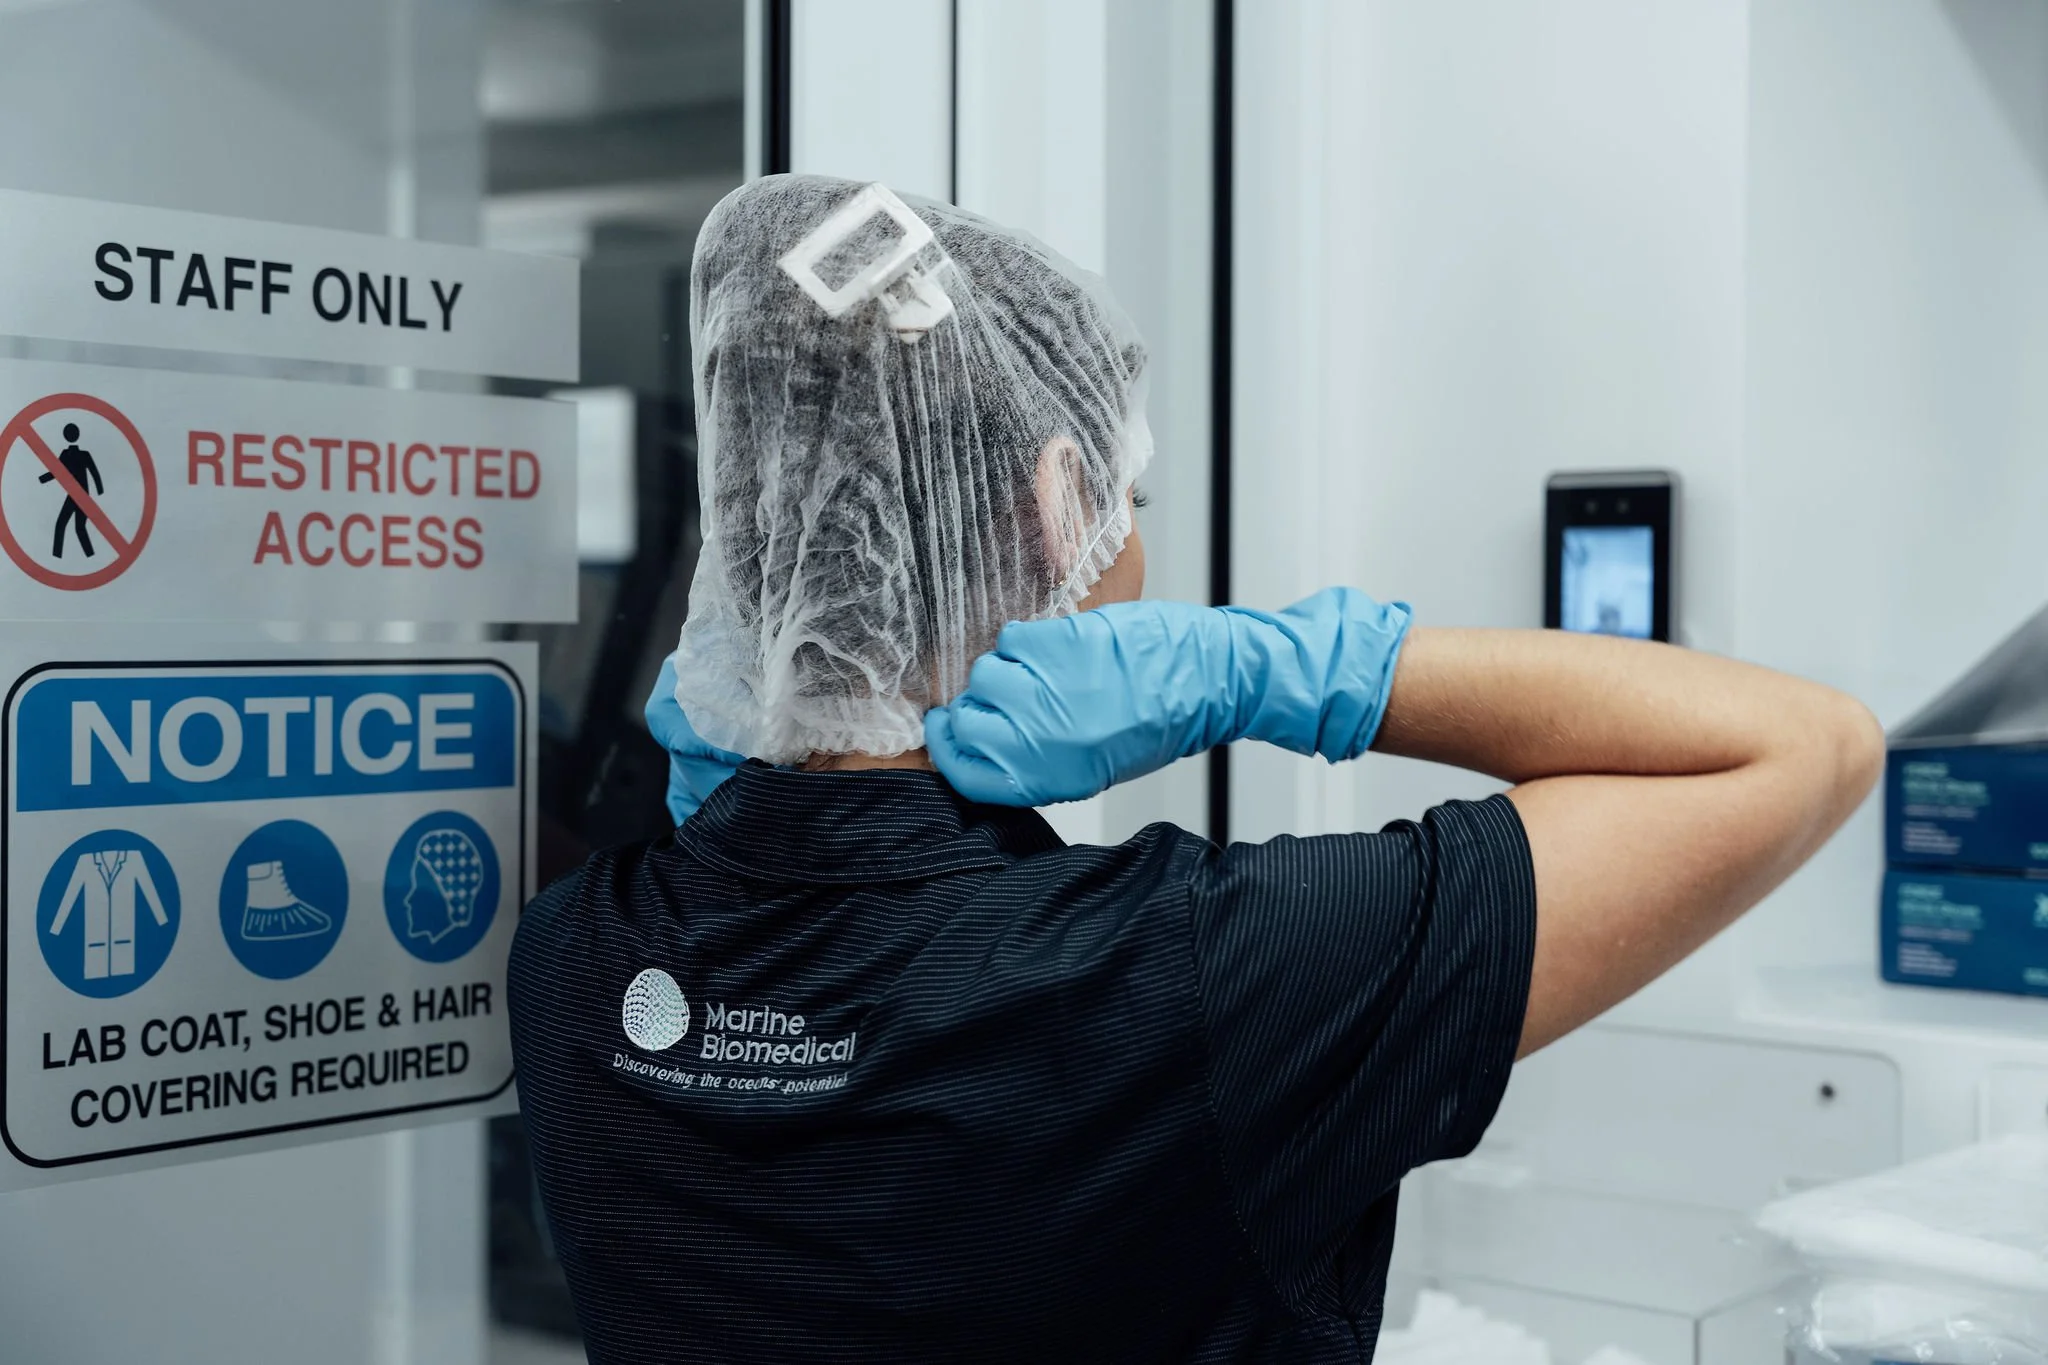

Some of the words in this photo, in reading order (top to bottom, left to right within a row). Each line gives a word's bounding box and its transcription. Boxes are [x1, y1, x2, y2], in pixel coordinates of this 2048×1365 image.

[95, 242, 293, 315] STAFF
[312, 267, 463, 332] ONLY
[187, 430, 541, 500] RESTRICTED
[253, 511, 484, 570] ACCESS
[71, 693, 475, 786] NOTICE
[42, 1024, 127, 1070] LAB
[140, 1010, 251, 1056] COAT,
[263, 996, 366, 1042] SHOE
[378, 993, 401, 1026] &
[413, 982, 493, 1023] HAIR
[700, 1032, 857, 1065] Biomedical
[704, 1002, 806, 1036] Marine
[70, 1066, 277, 1128] COVERING
[291, 1041, 469, 1101] REQUIRED
[612, 1053, 695, 1088] Discovering
[700, 1073, 721, 1088] the
[781, 1072, 849, 1094] potential
